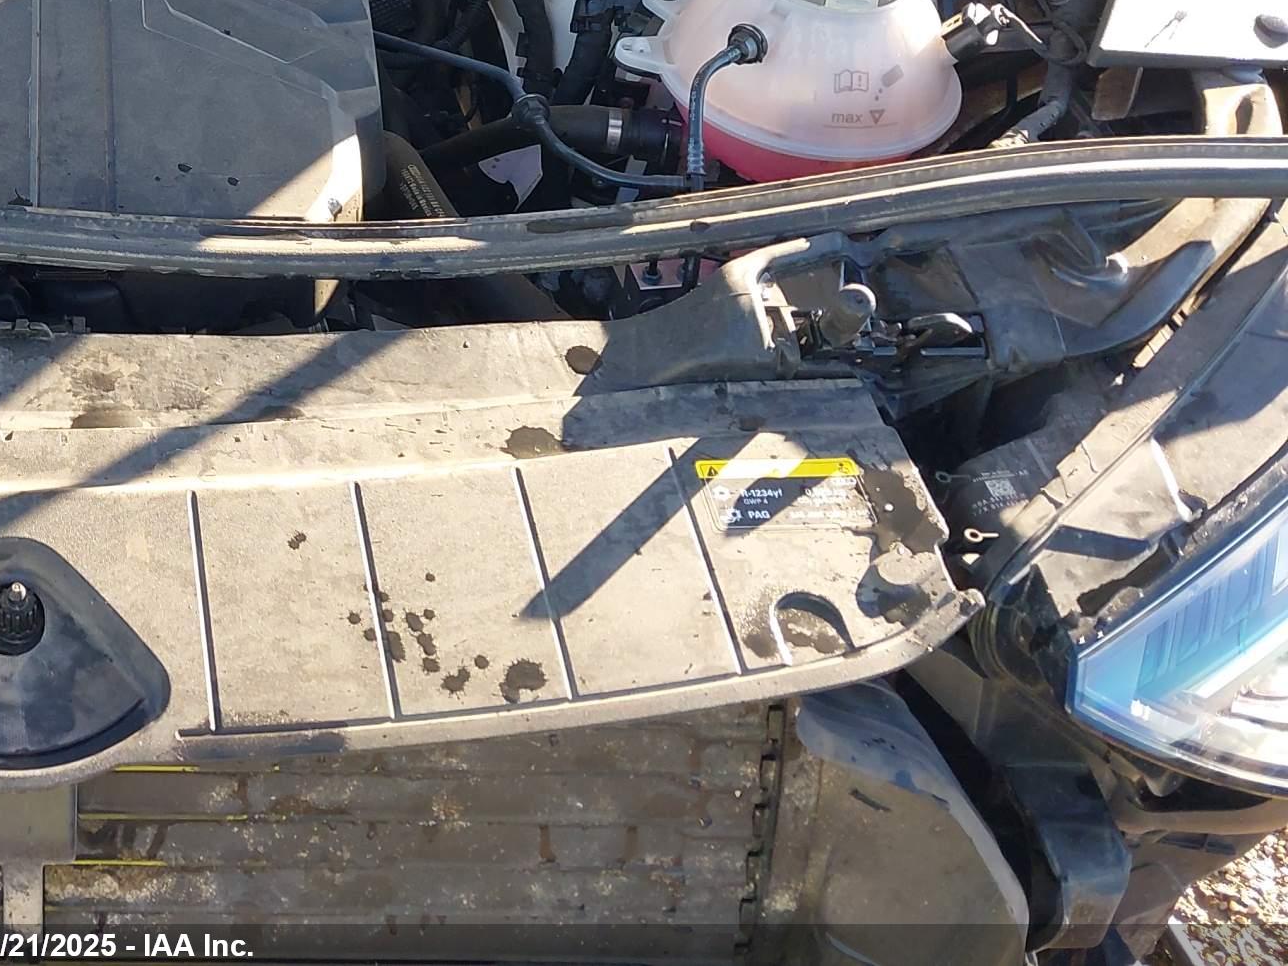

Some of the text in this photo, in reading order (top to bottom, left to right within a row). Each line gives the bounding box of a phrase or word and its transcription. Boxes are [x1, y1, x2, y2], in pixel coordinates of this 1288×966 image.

[831, 111, 863, 124] max
[740, 488, 783, 498] R-1234yf
[748, 510, 771, 519] PAG
